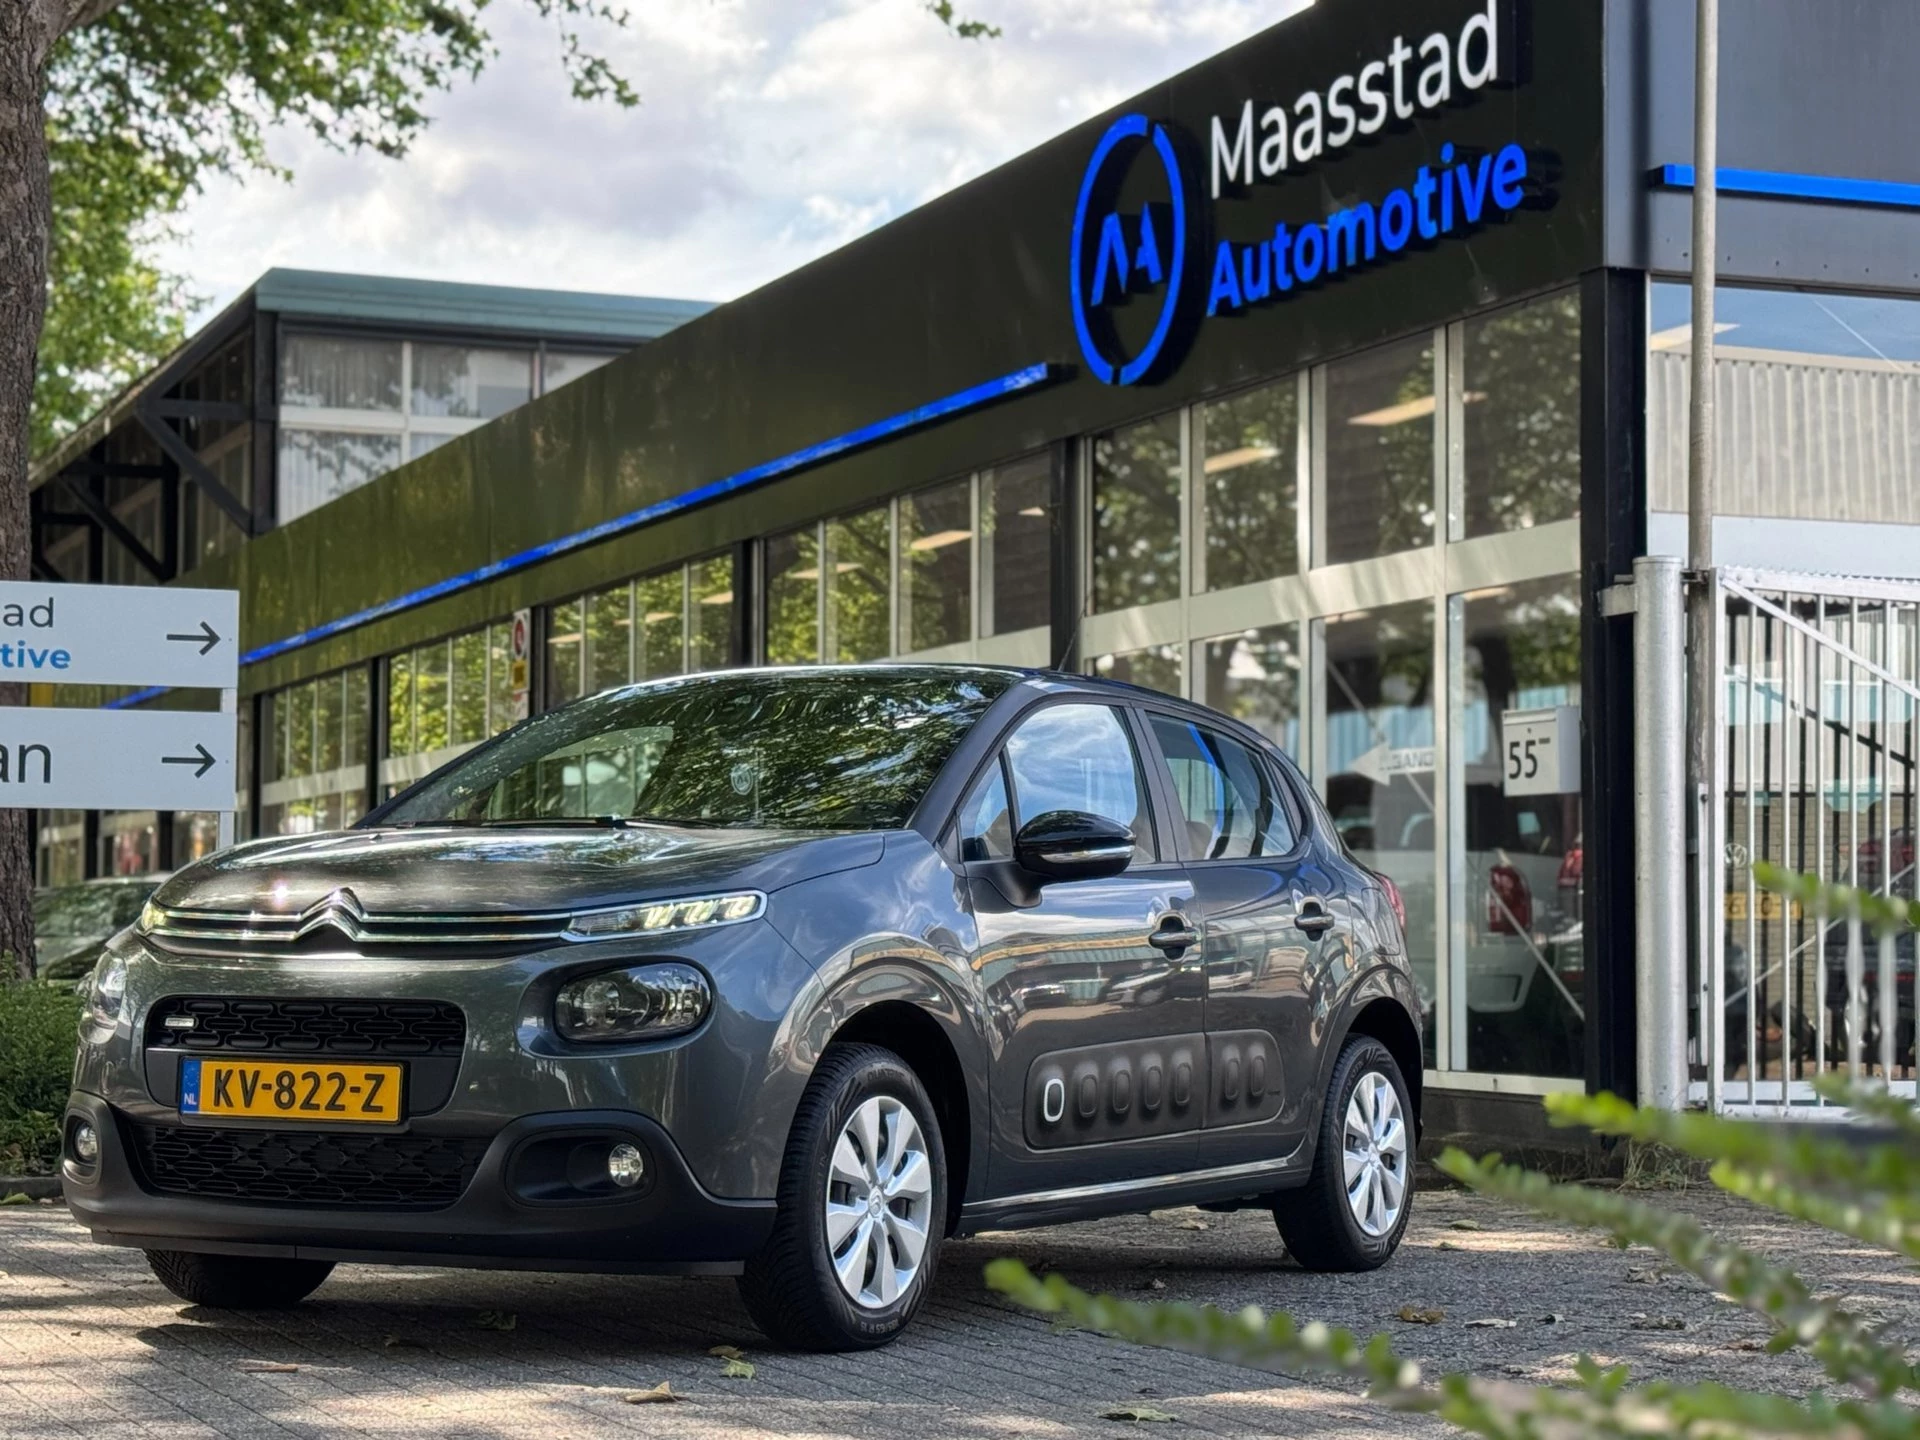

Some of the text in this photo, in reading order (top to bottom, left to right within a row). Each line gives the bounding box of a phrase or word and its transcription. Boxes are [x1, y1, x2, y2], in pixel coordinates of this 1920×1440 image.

[1211, 0, 1498, 199] Maasstad
[1207, 142, 1528, 317] Automotive
[3, 597, 54, 628] ad
[0, 639, 71, 669] tive
[183, 1092, 197, 1106] NL
[213, 1069, 385, 1112] KV-822-Z
